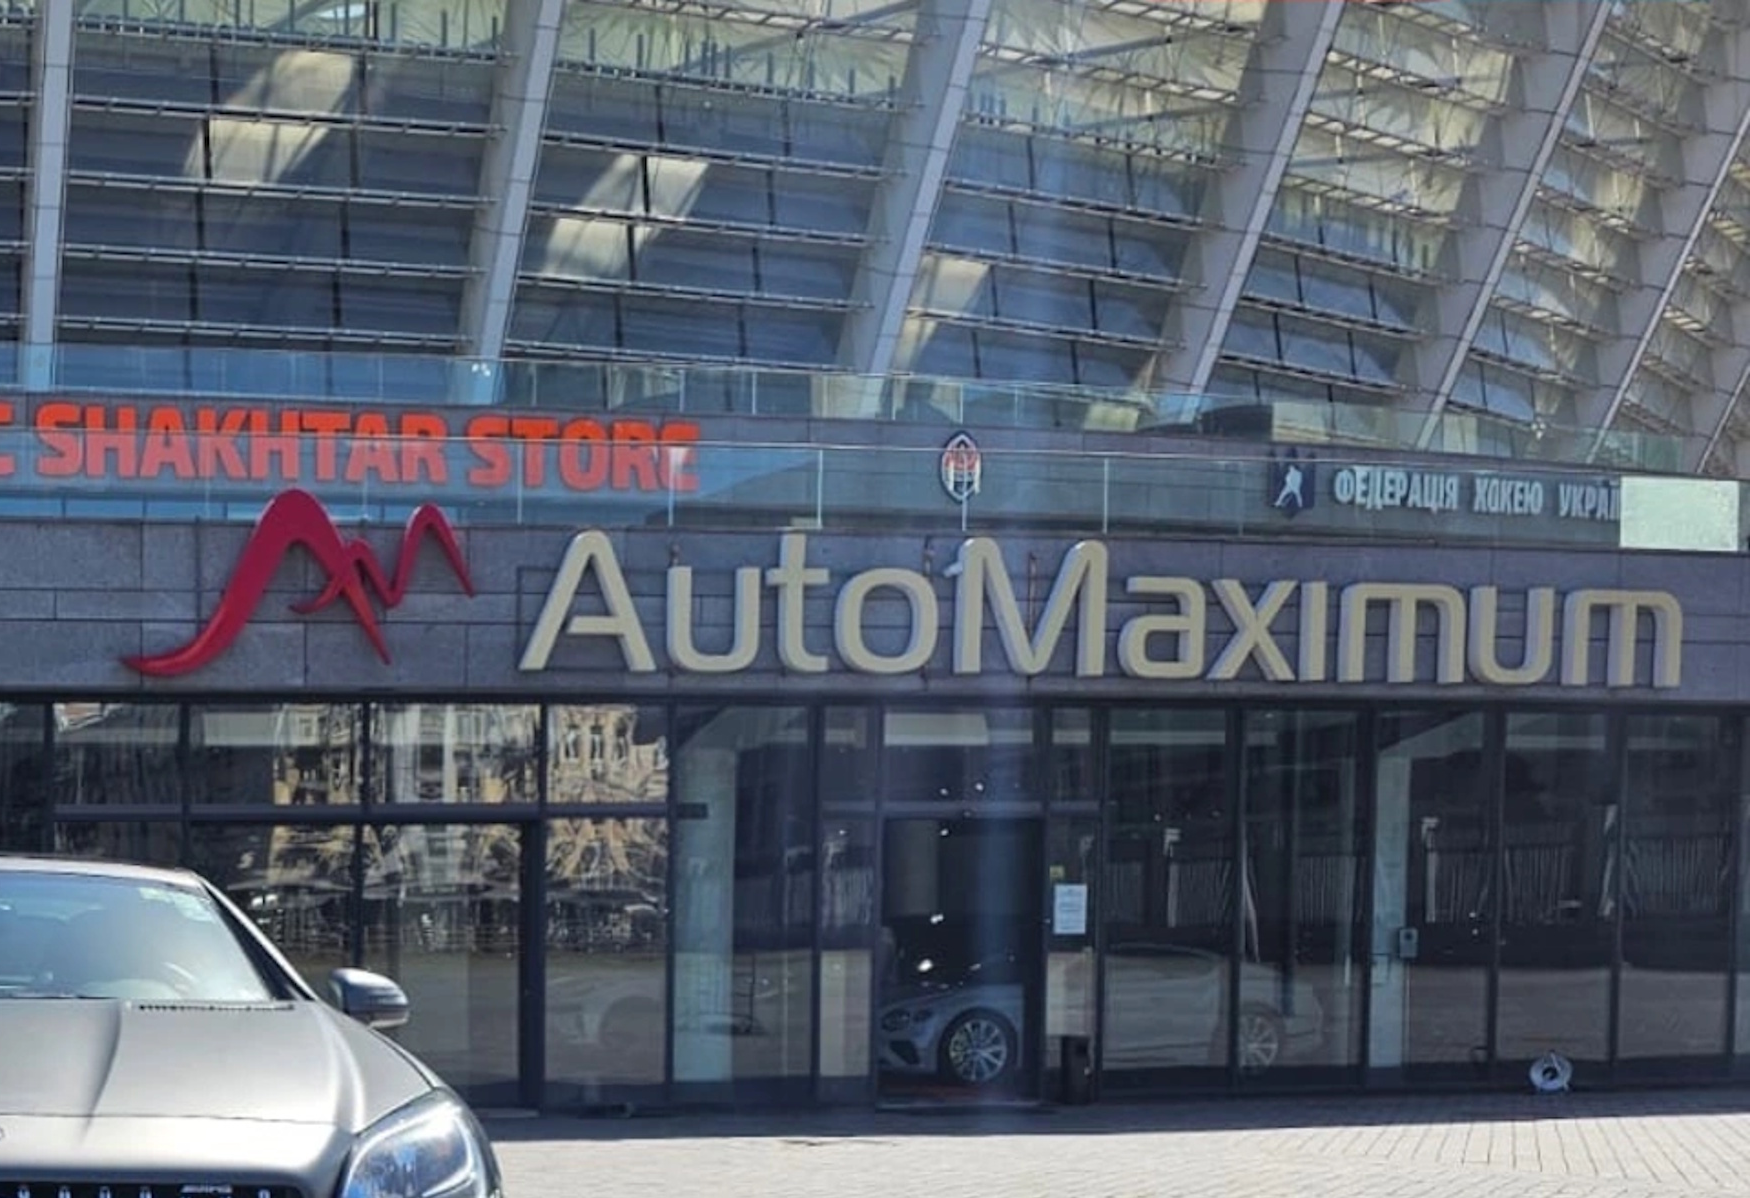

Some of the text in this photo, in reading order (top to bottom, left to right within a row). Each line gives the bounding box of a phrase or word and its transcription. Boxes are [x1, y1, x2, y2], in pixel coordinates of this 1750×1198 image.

[35, 403, 448, 483] SHAKHTAR
[467, 414, 700, 492] STORE
[1334, 468, 1621, 521] ФЕДЕРАЦІЯ ХОКЕЮ УКРАЇ
[518, 529, 1684, 688] AutoMaximum
